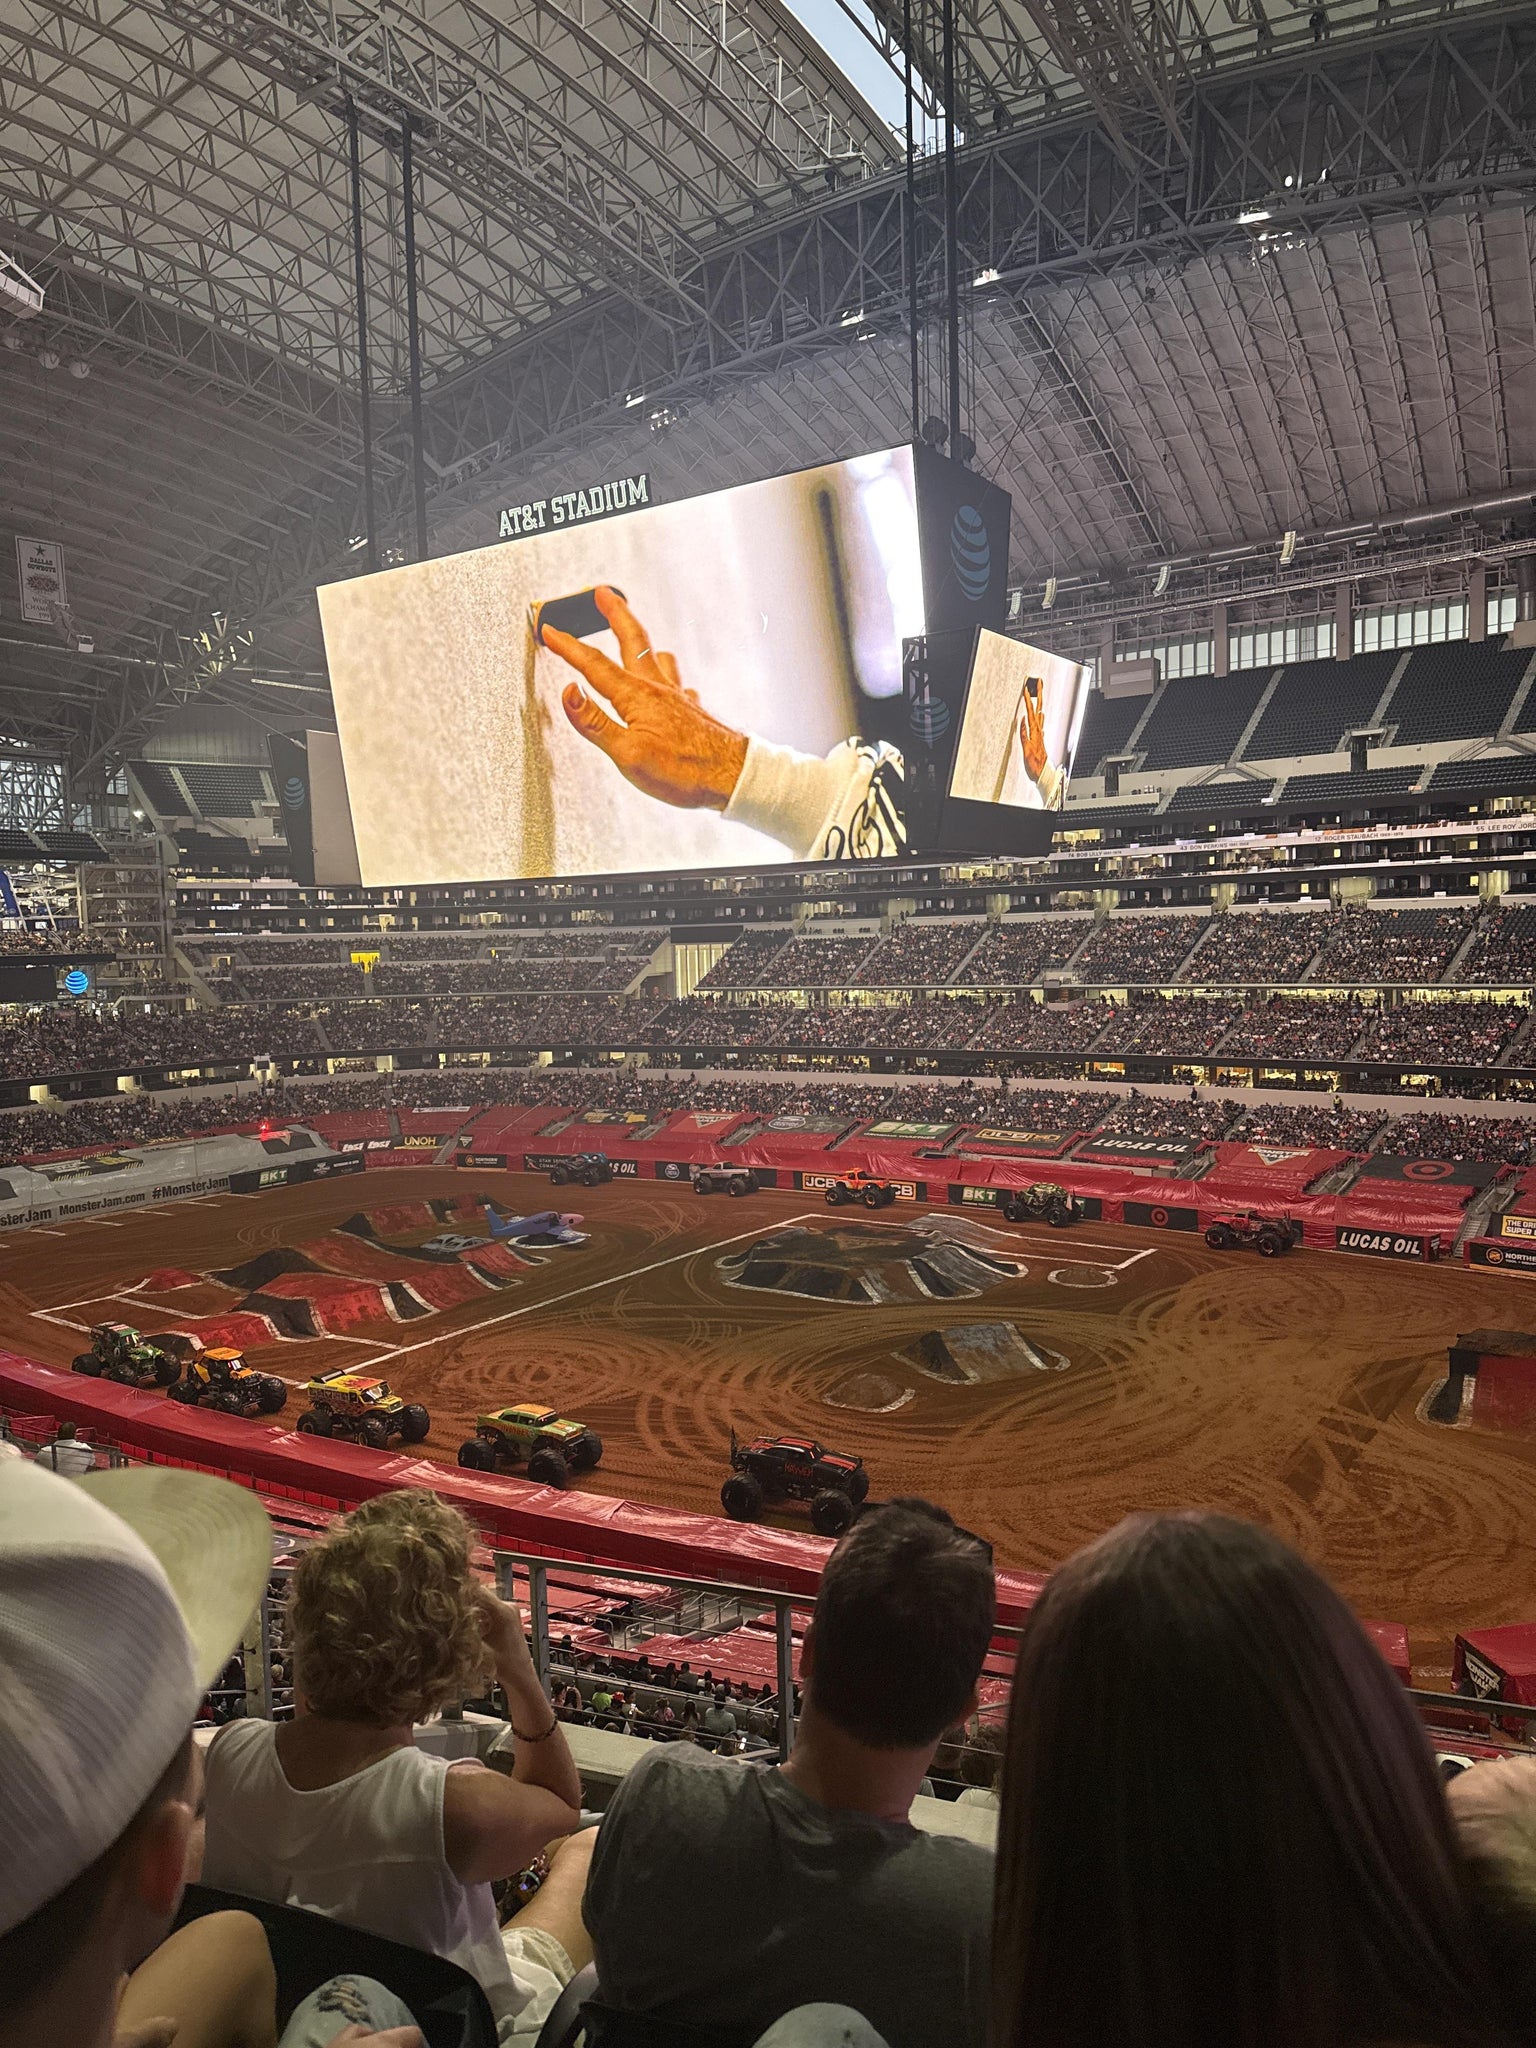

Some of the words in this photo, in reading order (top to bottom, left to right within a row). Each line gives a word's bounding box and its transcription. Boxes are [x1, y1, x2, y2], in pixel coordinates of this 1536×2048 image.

[499, 501, 547, 537] AT&T
[550, 475, 649, 524] STADIUM
[868, 1121, 949, 1134] BKT
[404, 1136, 437, 1145] UNOH
[1092, 1138, 1152, 1151] LUCAS
[1156, 1143, 1190, 1153] OIL
[620, 1162, 636, 1174] OIL
[259, 1168, 288, 1184] BKT
[806, 1174, 836, 1188] JCB
[152, 1175, 229, 1199] #MonsterJam
[891, 1184, 913, 1196] CB
[963, 1187, 997, 1201] BKT
[59, 1192, 146, 1216] MonsterJam.com
[0, 1208, 52, 1227] sterJam
[1506, 1219, 1522, 1227] THE
[1506, 1226, 1532, 1236] SUPER
[1340, 1232, 1391, 1250] LUCAS
[1394, 1238, 1421, 1255] OIL
